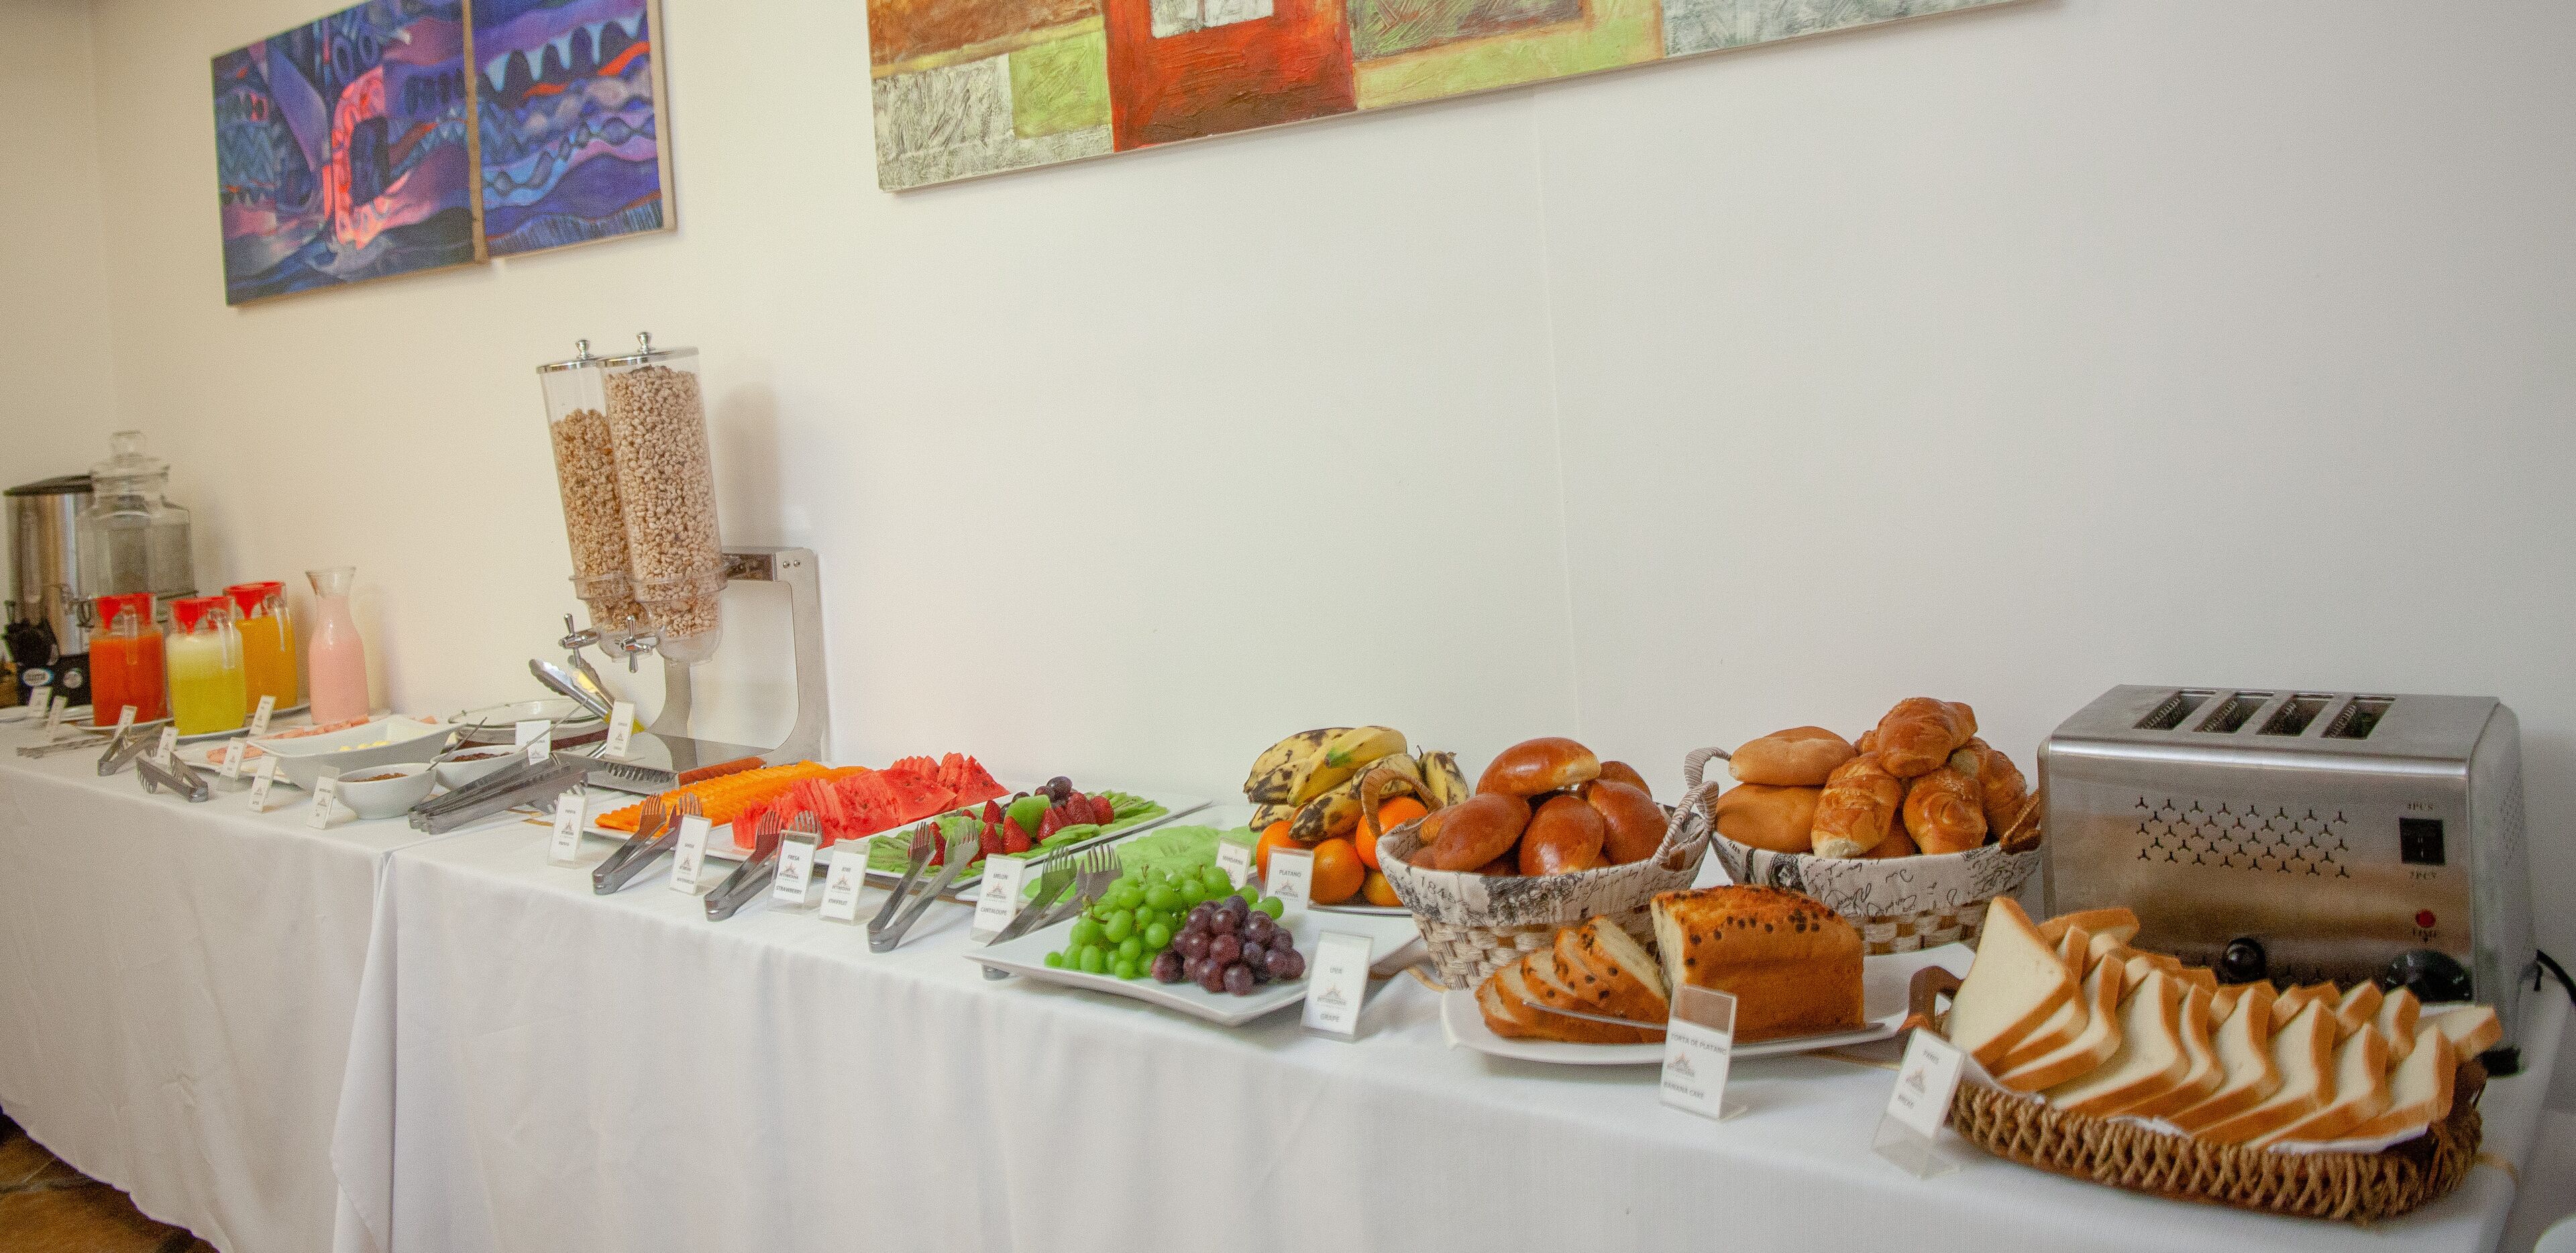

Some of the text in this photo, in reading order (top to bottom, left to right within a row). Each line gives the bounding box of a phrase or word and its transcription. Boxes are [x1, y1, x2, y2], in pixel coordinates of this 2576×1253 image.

[1279, 869, 1301, 877] PLATANO
[776, 885, 802, 895] STRAWBERRY
[981, 907, 1007, 916] CANTALOUPE
[1320, 1014, 1340, 1022] GRAPE
[1671, 1034, 1689, 1044] TORTA
[1699, 1042, 1727, 1056] PLATANO
